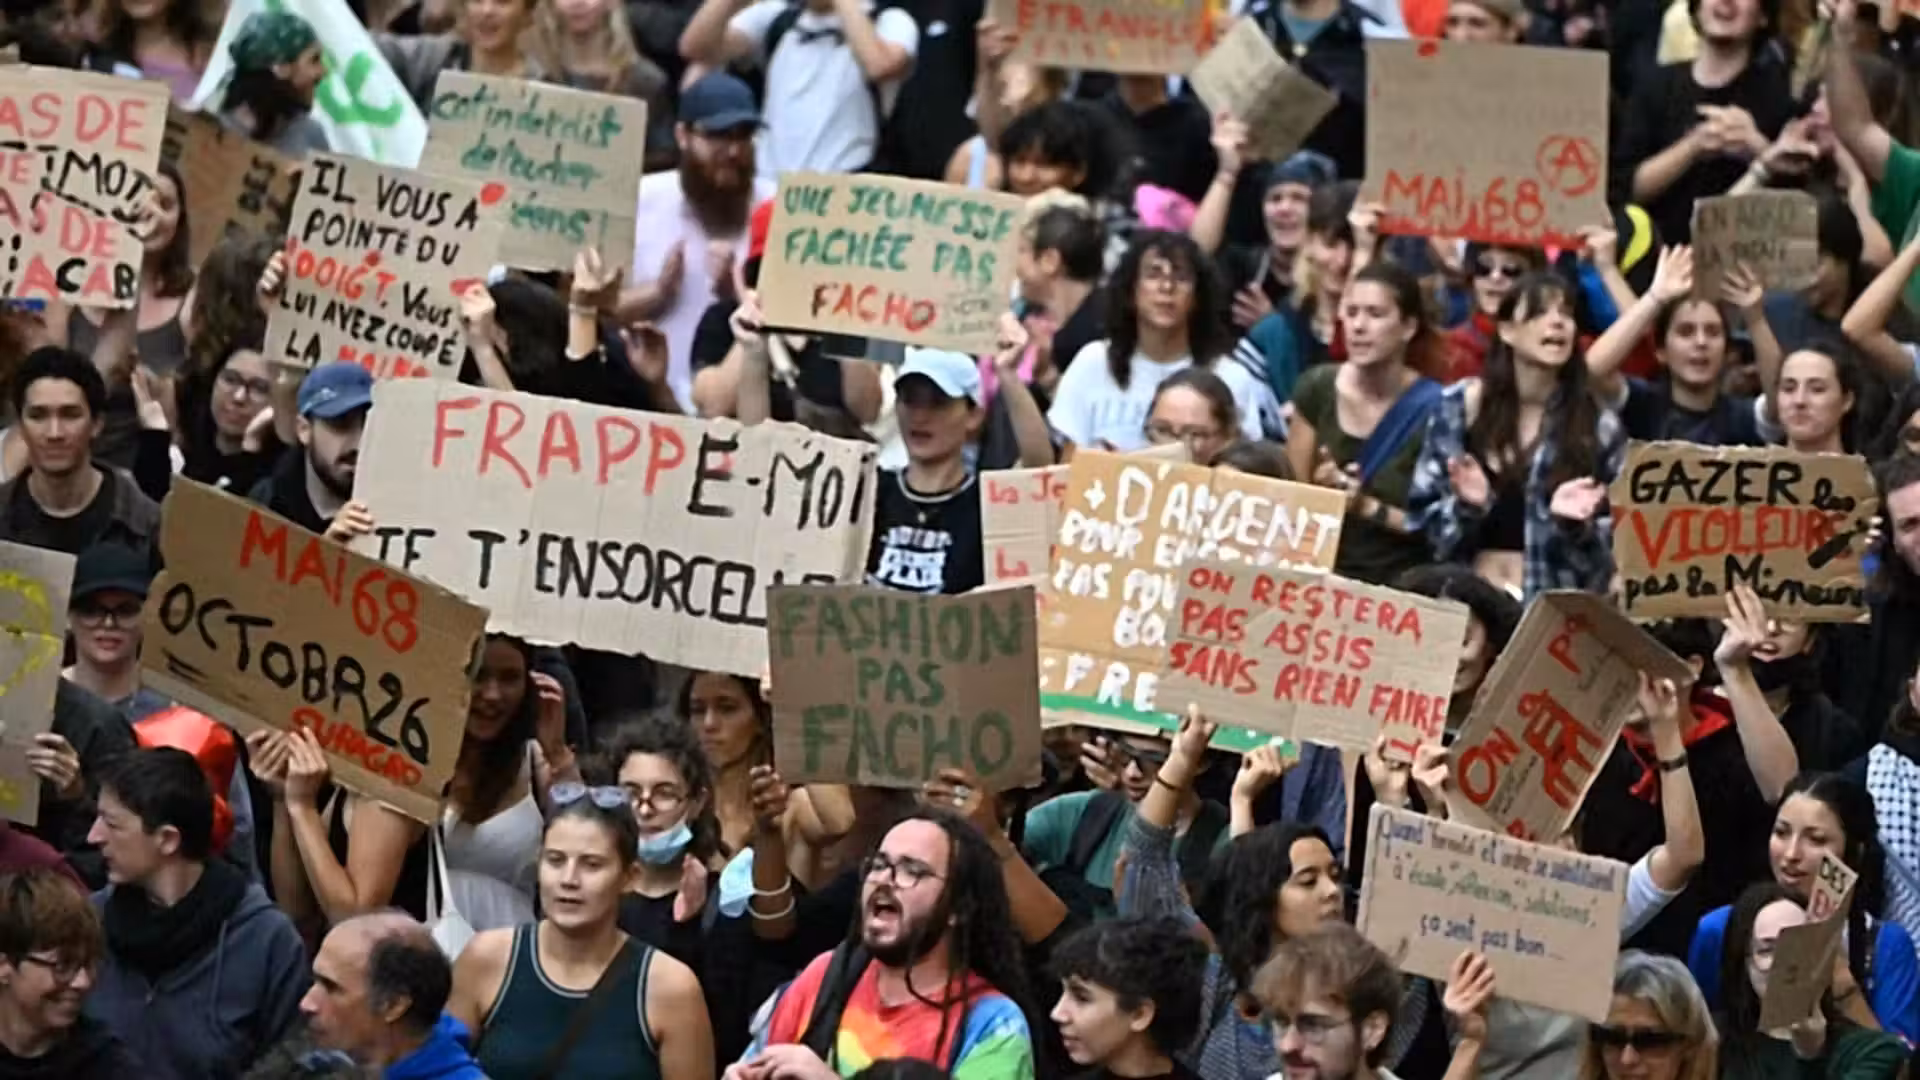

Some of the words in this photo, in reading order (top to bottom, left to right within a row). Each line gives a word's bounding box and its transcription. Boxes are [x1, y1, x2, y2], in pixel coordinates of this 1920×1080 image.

[0, 93, 63, 140] AS
[75, 93, 146, 153] DE
[309, 158, 357, 204] IL
[375, 173, 453, 227] VOUS
[454, 196, 479, 232] A
[783, 185, 834, 218] UNE
[848, 184, 1015, 243] JEUNESSE
[1483, 175, 1546, 228] 68
[60, 205, 117, 258] DE
[416, 235, 461, 266] DU
[783, 222, 914, 273] FACHÉE
[931, 241, 997, 285] PAS
[15, 254, 136, 300] ACAB
[279, 287, 317, 319] LUI
[322, 299, 386, 343] AVEZ
[811, 281, 937, 333] FACHO
[285, 327, 322, 370] LA
[1629, 458, 1804, 506] GAZER
[1058, 508, 1144, 560] POUR
[1115, 463, 1341, 557] D'ARGENT
[467, 527, 838, 628] T'ENSORCEL
[994, 544, 1030, 579] La
[351, 567, 419, 654] 68
[1122, 565, 1179, 612] POU
[1188, 567, 1236, 596] ON
[1251, 572, 1423, 646] RESTERA
[1625, 572, 1681, 611] pas
[1180, 597, 1249, 643] PAS
[858, 657, 945, 708] PAS
[1168, 641, 1260, 697] SANS
[1273, 662, 1362, 709] RIEN
[1367, 683, 1447, 739] FAIRE
[802, 702, 1015, 781] FACHO
[1457, 726, 1521, 807] ON
[1378, 811, 1425, 859] Quand
[1821, 855, 1847, 894] DES
[1480, 928, 1510, 952] pas
